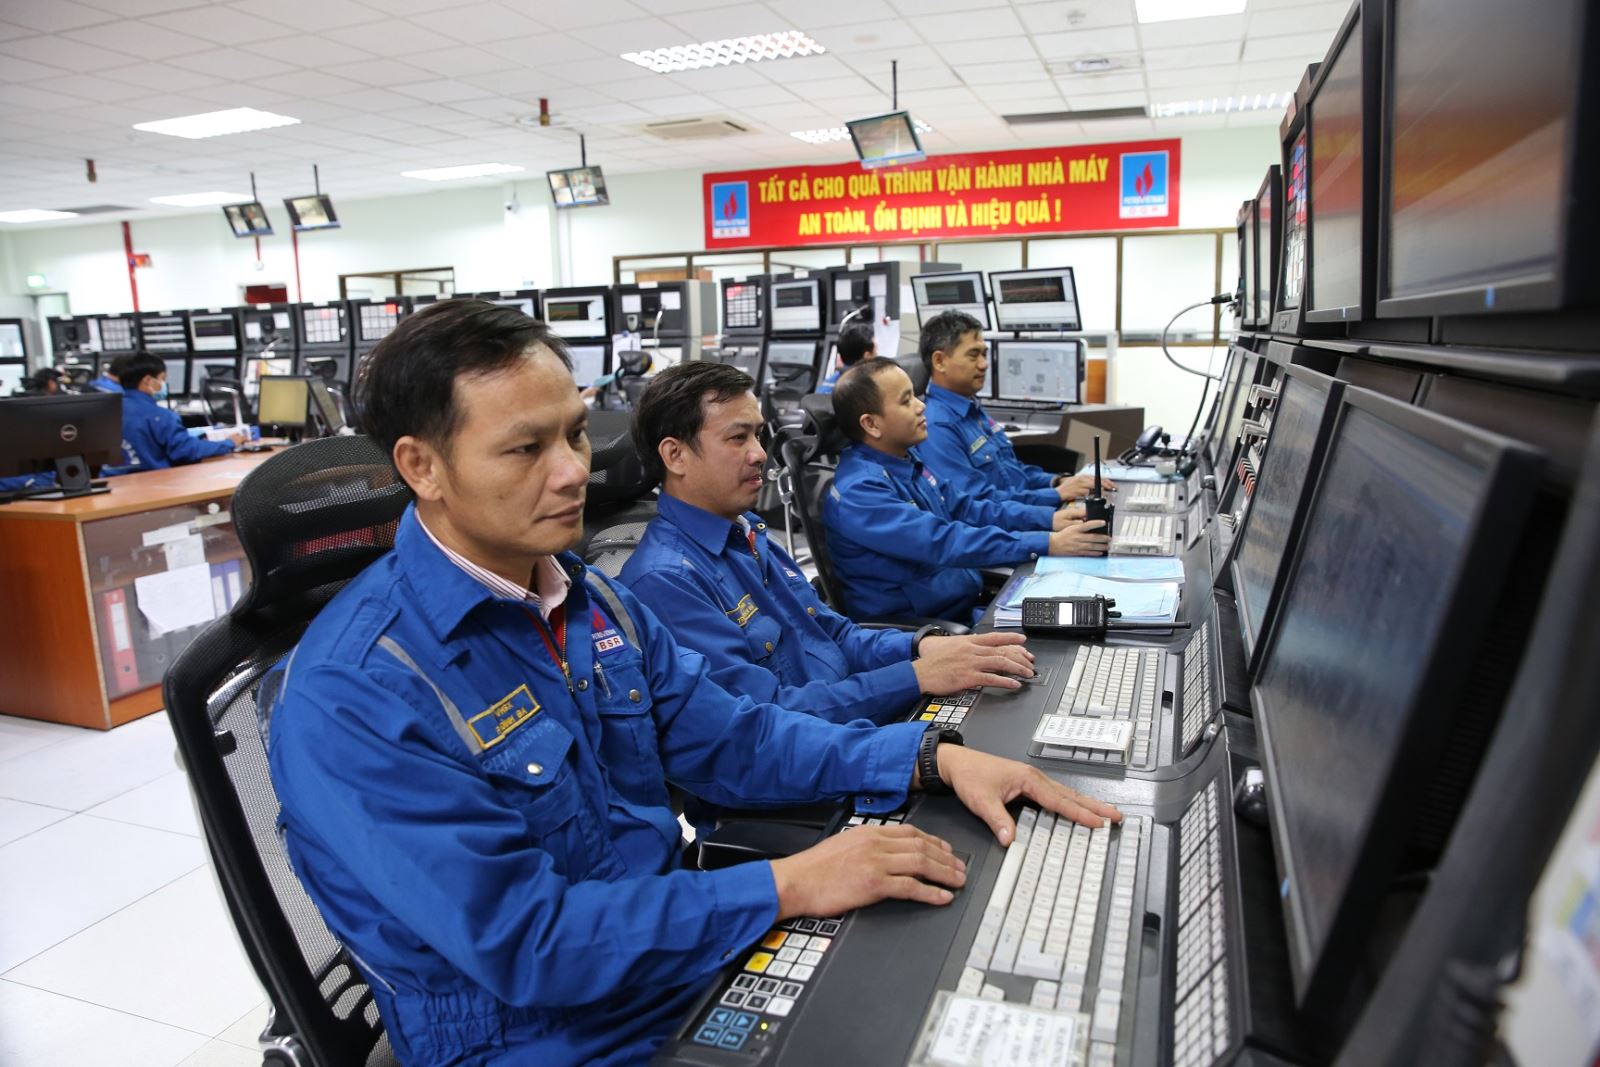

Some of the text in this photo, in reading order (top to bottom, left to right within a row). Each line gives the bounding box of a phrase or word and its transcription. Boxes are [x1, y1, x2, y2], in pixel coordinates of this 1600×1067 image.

[758, 174, 785, 204] TẤT
[788, 172, 811, 202] CẢ
[813, 175, 845, 200] CHO
[883, 166, 933, 195] TRÌNH
[936, 163, 971, 196] VẬN
[975, 161, 1022, 189] HÀNH
[1027, 156, 1065, 186] NHÀ
[1069, 154, 1109, 183] MÁY
[798, 212, 821, 236] AN
[824, 207, 870, 236] TOÀN,
[873, 200, 898, 232] ỔN
[901, 205, 942, 234] ĐỊNH
[946, 200, 969, 228] VÀ
[971, 198, 1011, 230] HIỆU
[1015, 193, 1050, 226] QUẢ
[599, 637, 620, 650] BSR
